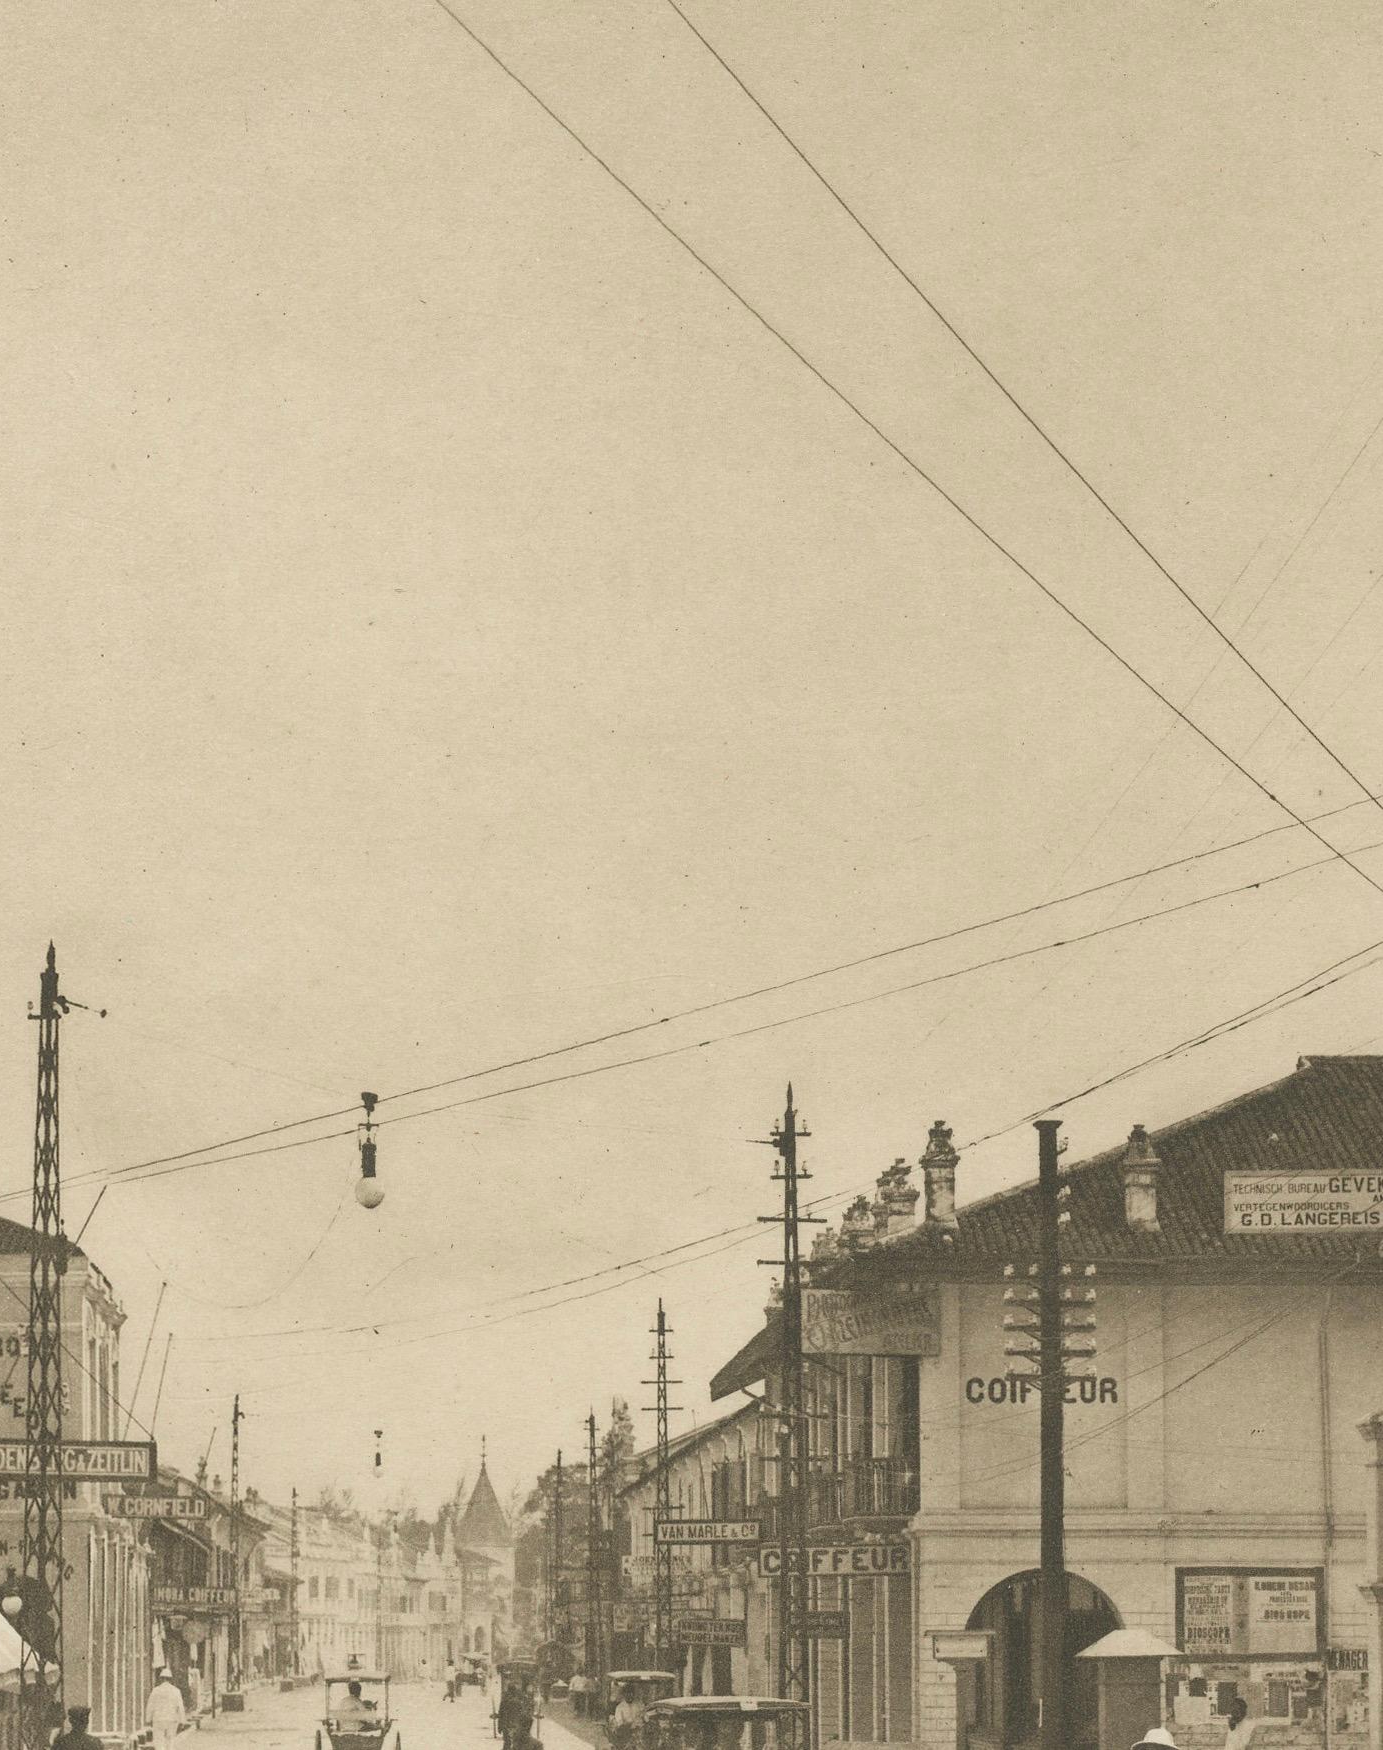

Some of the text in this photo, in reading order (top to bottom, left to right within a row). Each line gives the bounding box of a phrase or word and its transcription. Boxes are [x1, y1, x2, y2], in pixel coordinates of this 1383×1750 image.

[1234, 1184, 1283, 1195] TECHNISCH
[1288, 1183, 1326, 1194] BUREAU
[1281, 1211, 1380, 1225] LANGEREIS
[966, 1377, 1118, 1404] COIFEUR
[87, 1449, 147, 1473] ZEITLIN
[125, 1498, 206, 1515] CORNFIELD
[661, 1526, 684, 1539] VAN
[687, 1524, 728, 1538] MARLE
[763, 1548, 908, 1574] CFFEUR
